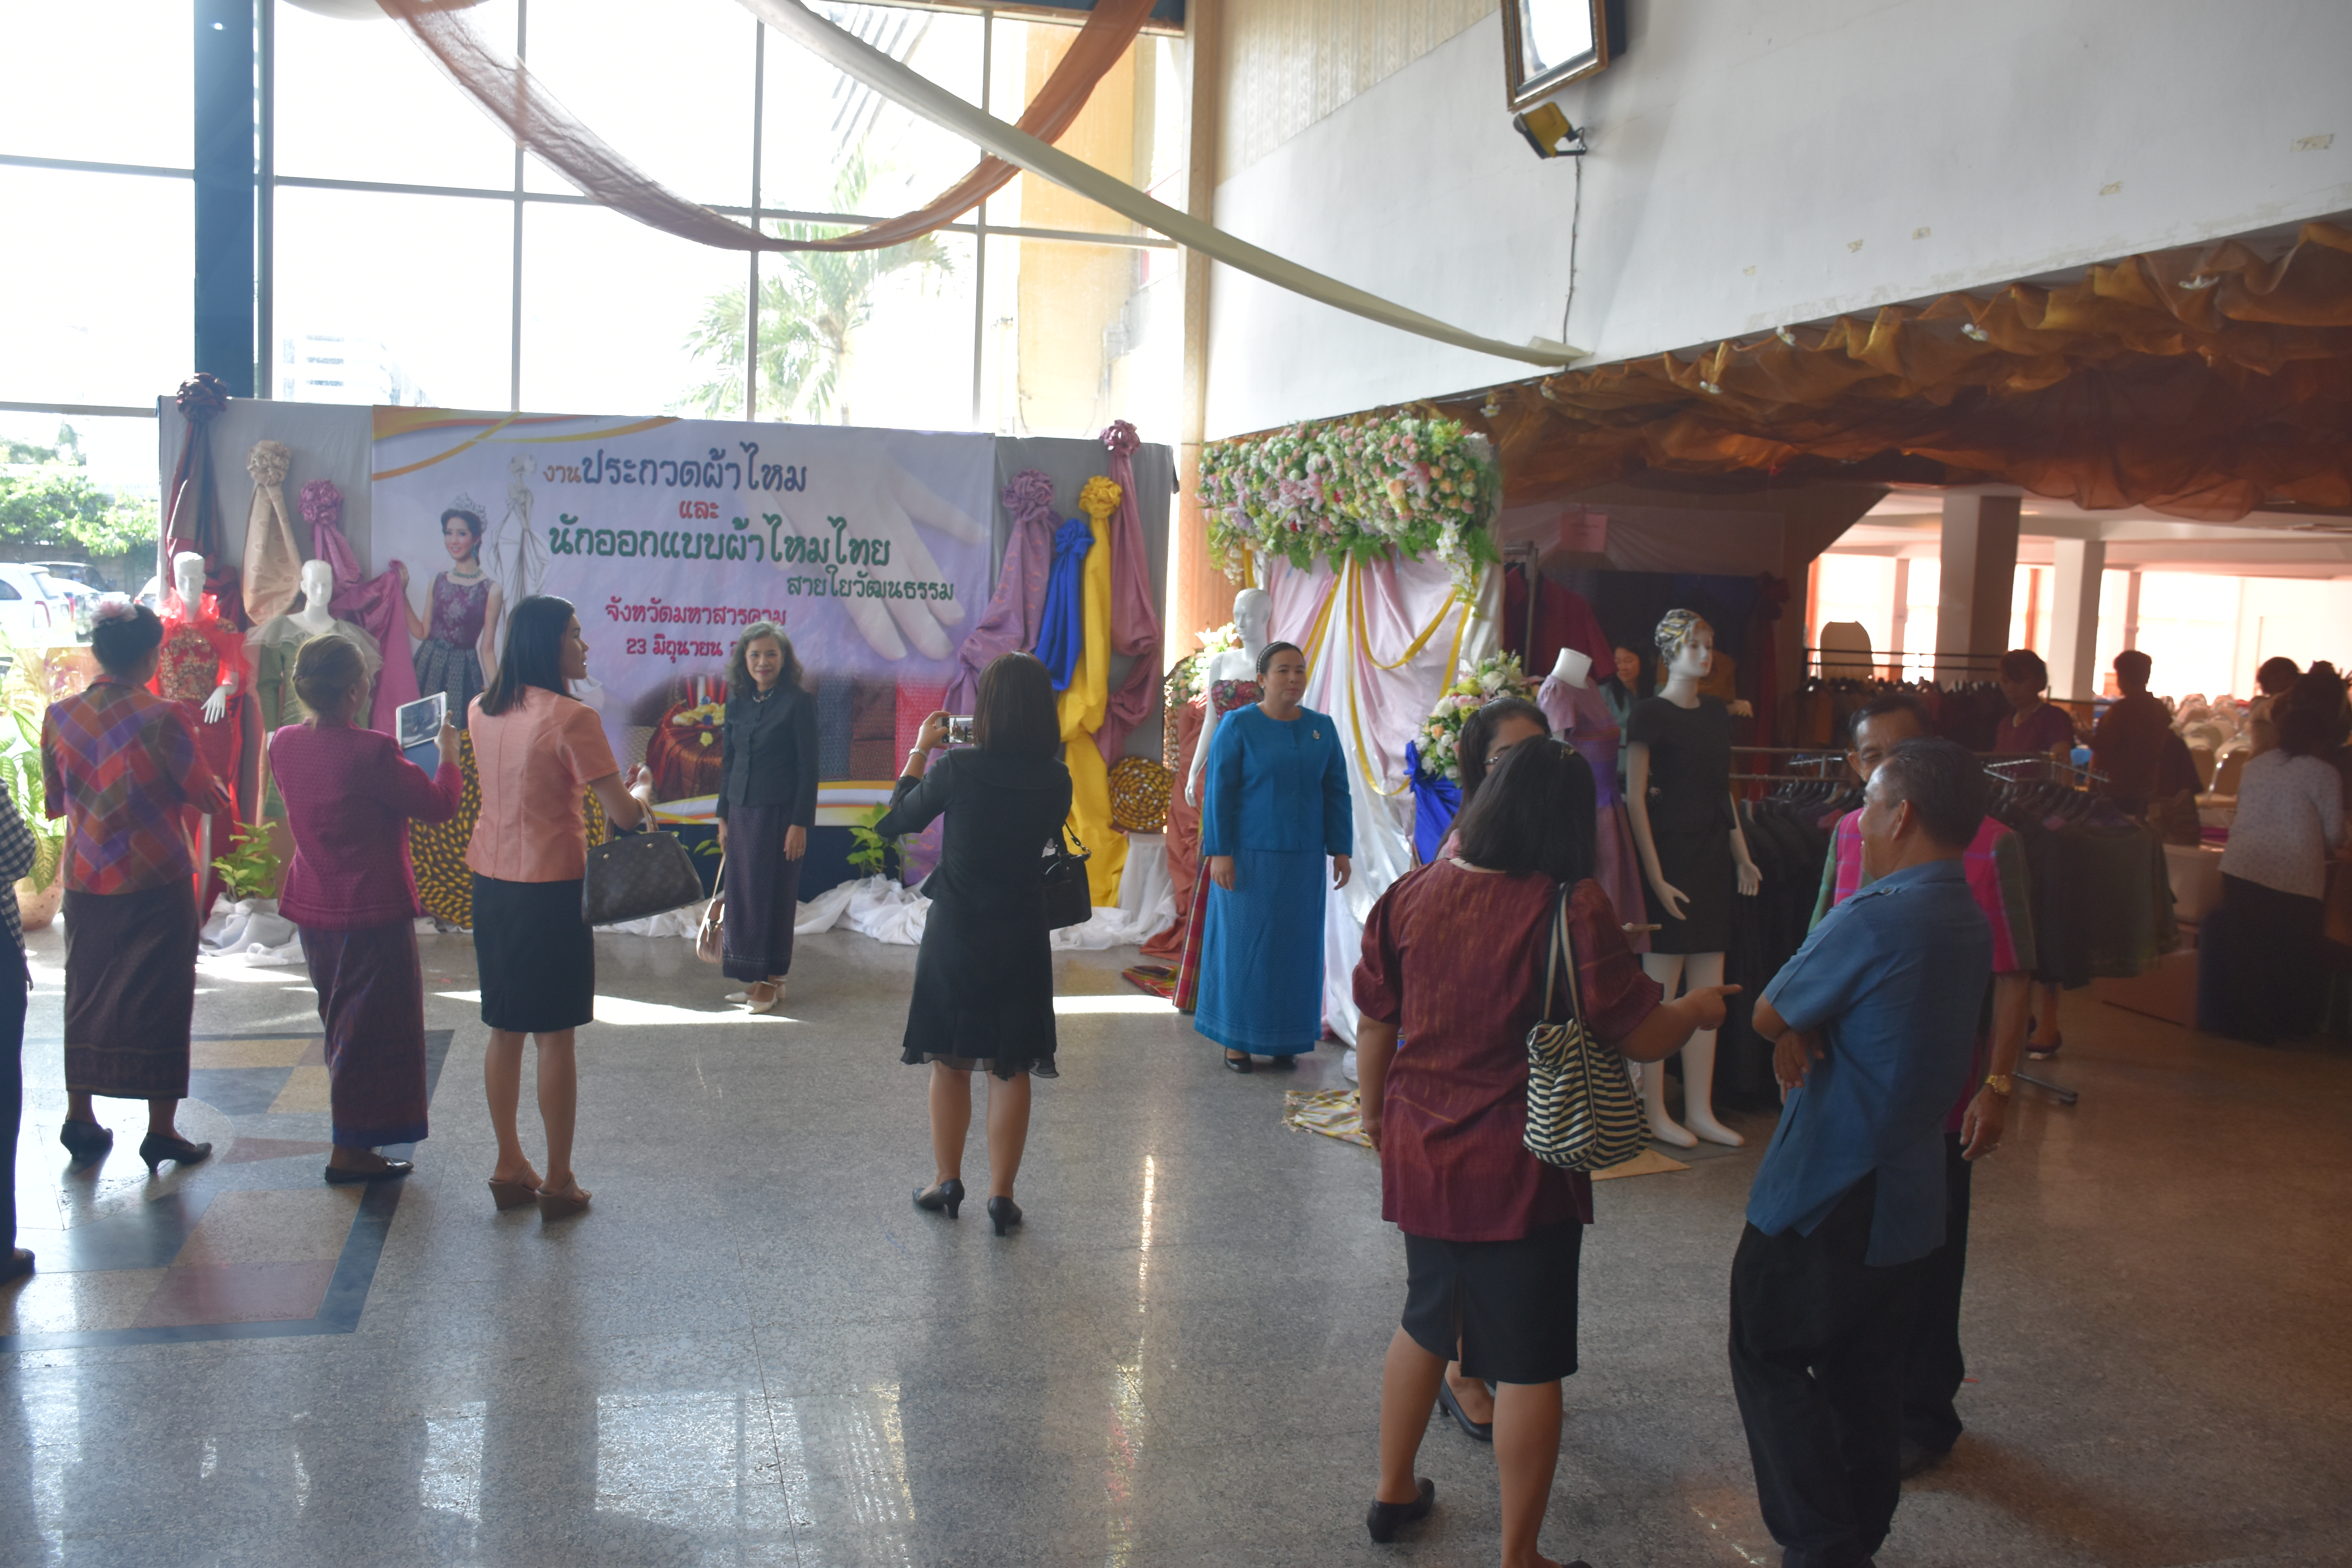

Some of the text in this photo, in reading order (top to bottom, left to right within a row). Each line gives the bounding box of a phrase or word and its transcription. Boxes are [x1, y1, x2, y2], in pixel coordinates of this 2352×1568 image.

[679, 501, 719, 519] และ
[549, 513, 890, 566] นักออกแบบผ้าไหมไทย
[788, 564, 954, 601] สายใยวัฒนธรรม
[626, 638, 646, 655] 23
[653, 633, 723, 663] มิถุนายน
